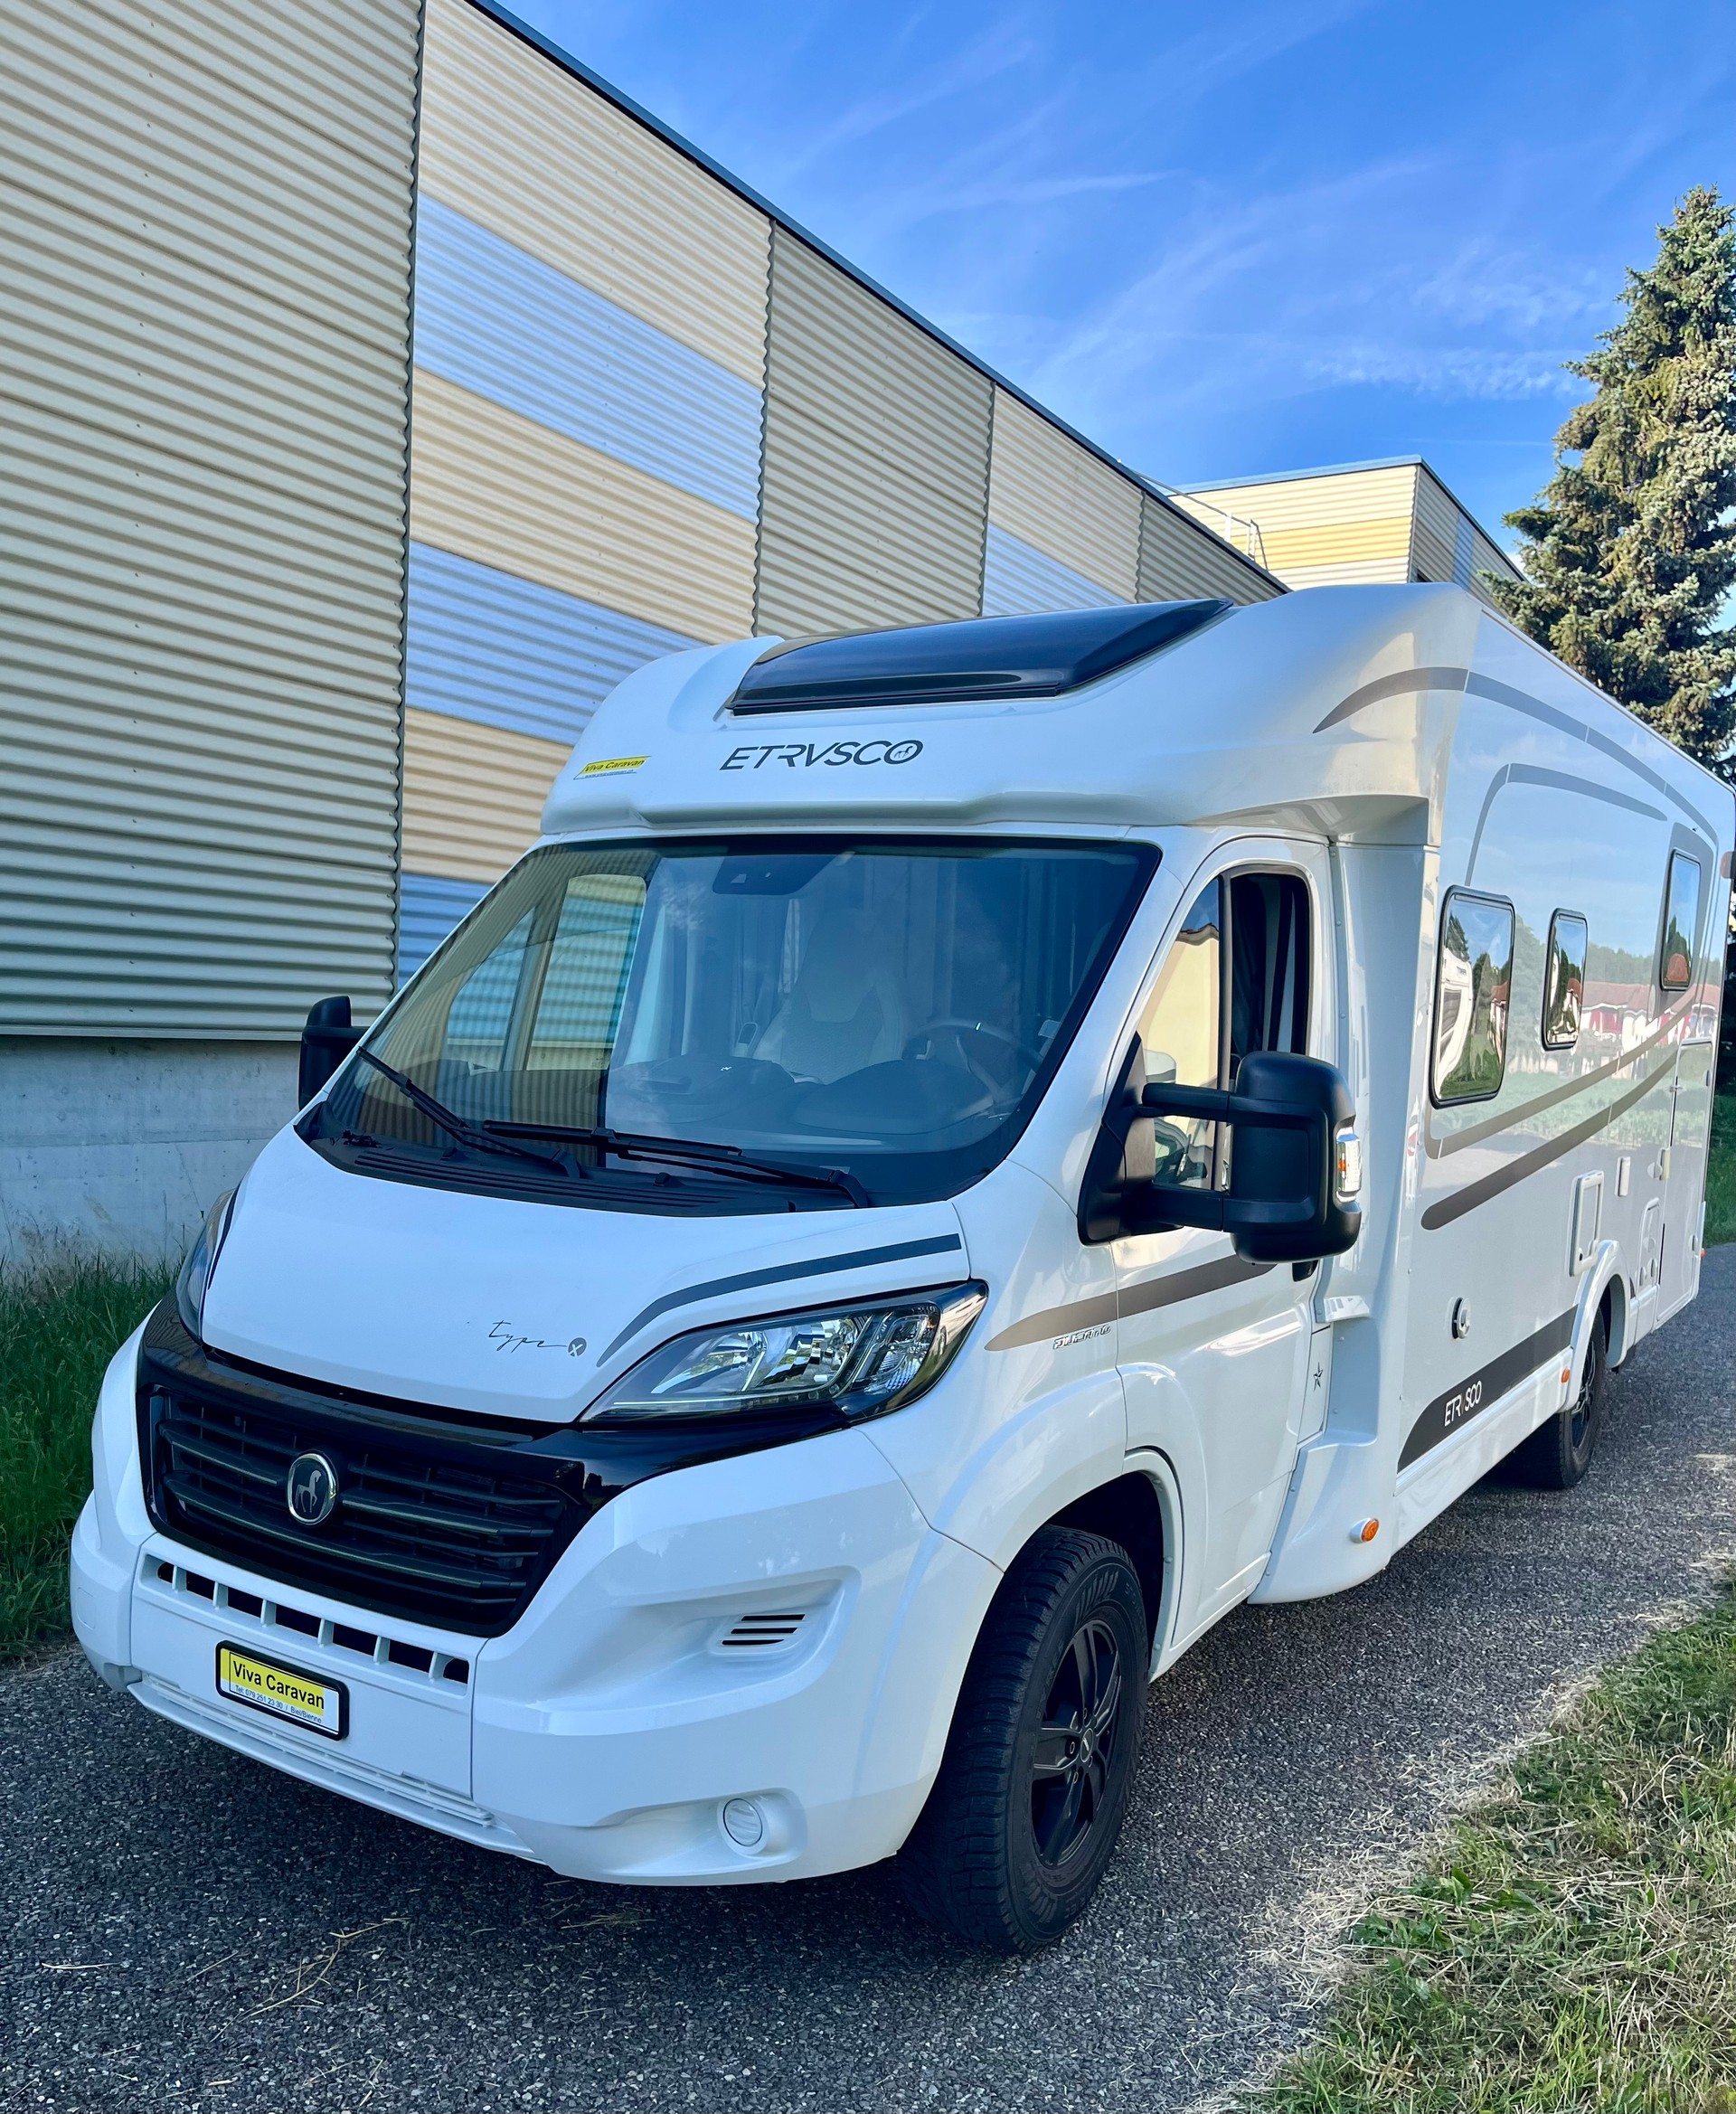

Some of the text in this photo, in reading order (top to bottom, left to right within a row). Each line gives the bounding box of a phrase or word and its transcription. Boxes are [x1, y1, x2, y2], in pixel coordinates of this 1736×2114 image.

[585, 760, 645, 772] Viva Caravan
[232, 1660, 325, 1709] Viva Caravan
